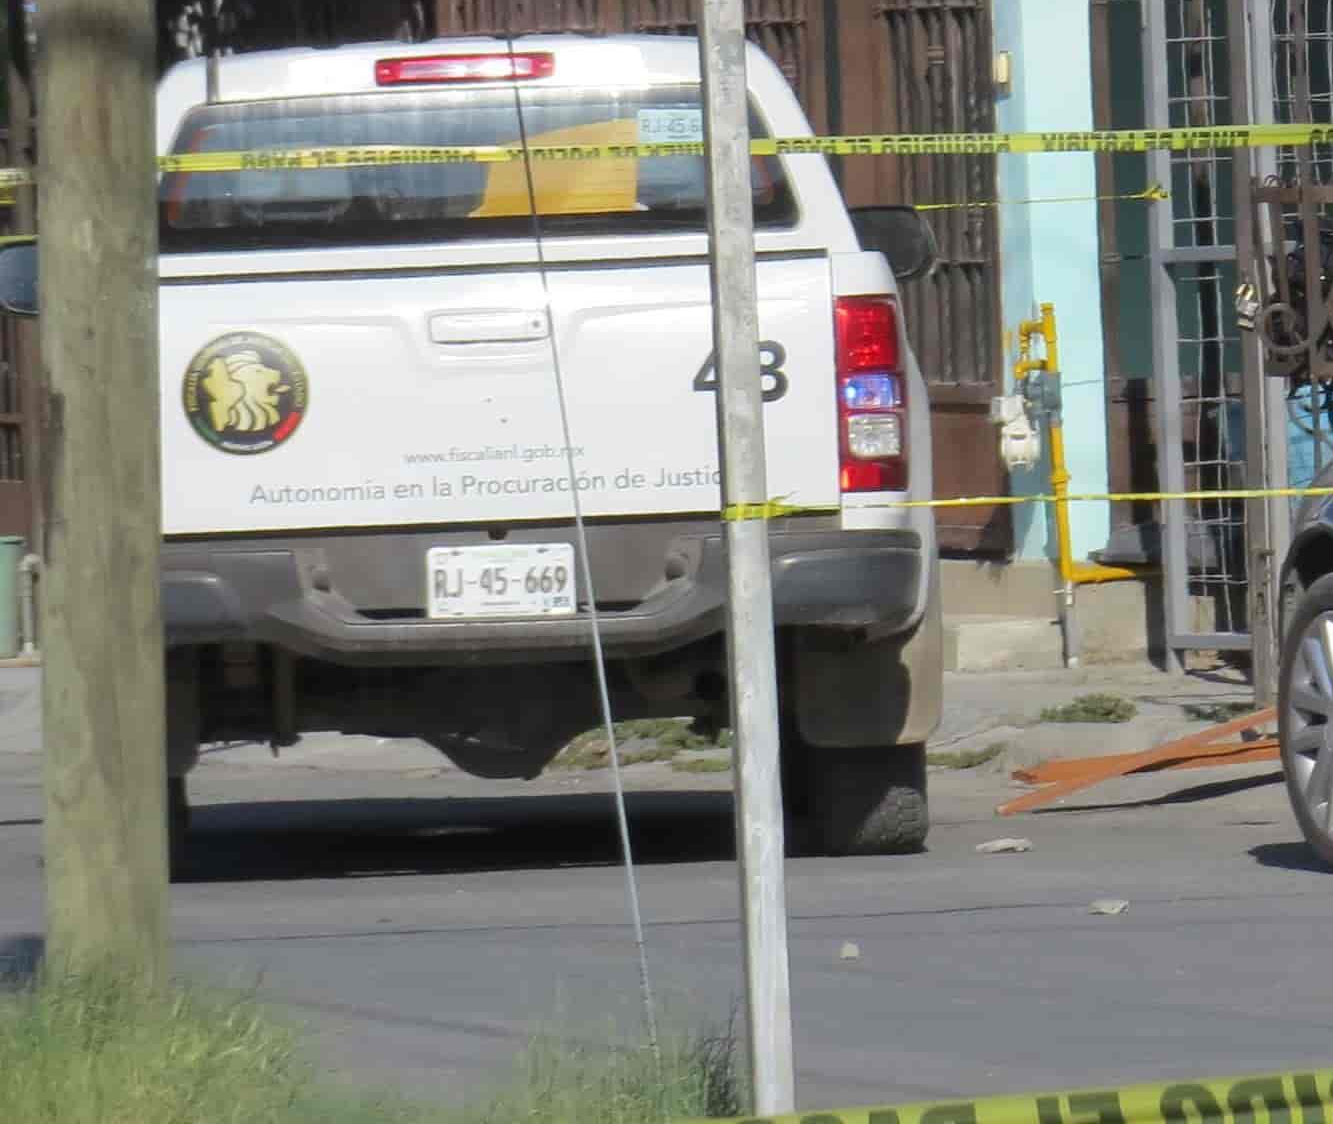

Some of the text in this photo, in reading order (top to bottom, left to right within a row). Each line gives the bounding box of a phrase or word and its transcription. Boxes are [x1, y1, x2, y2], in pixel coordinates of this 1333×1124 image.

[250, 477, 386, 505] Autonomía
[393, 482, 424, 499] en
[432, 475, 452, 497] la
[614, 467, 646, 489] de
[433, 564, 569, 599] RJ-45-669
